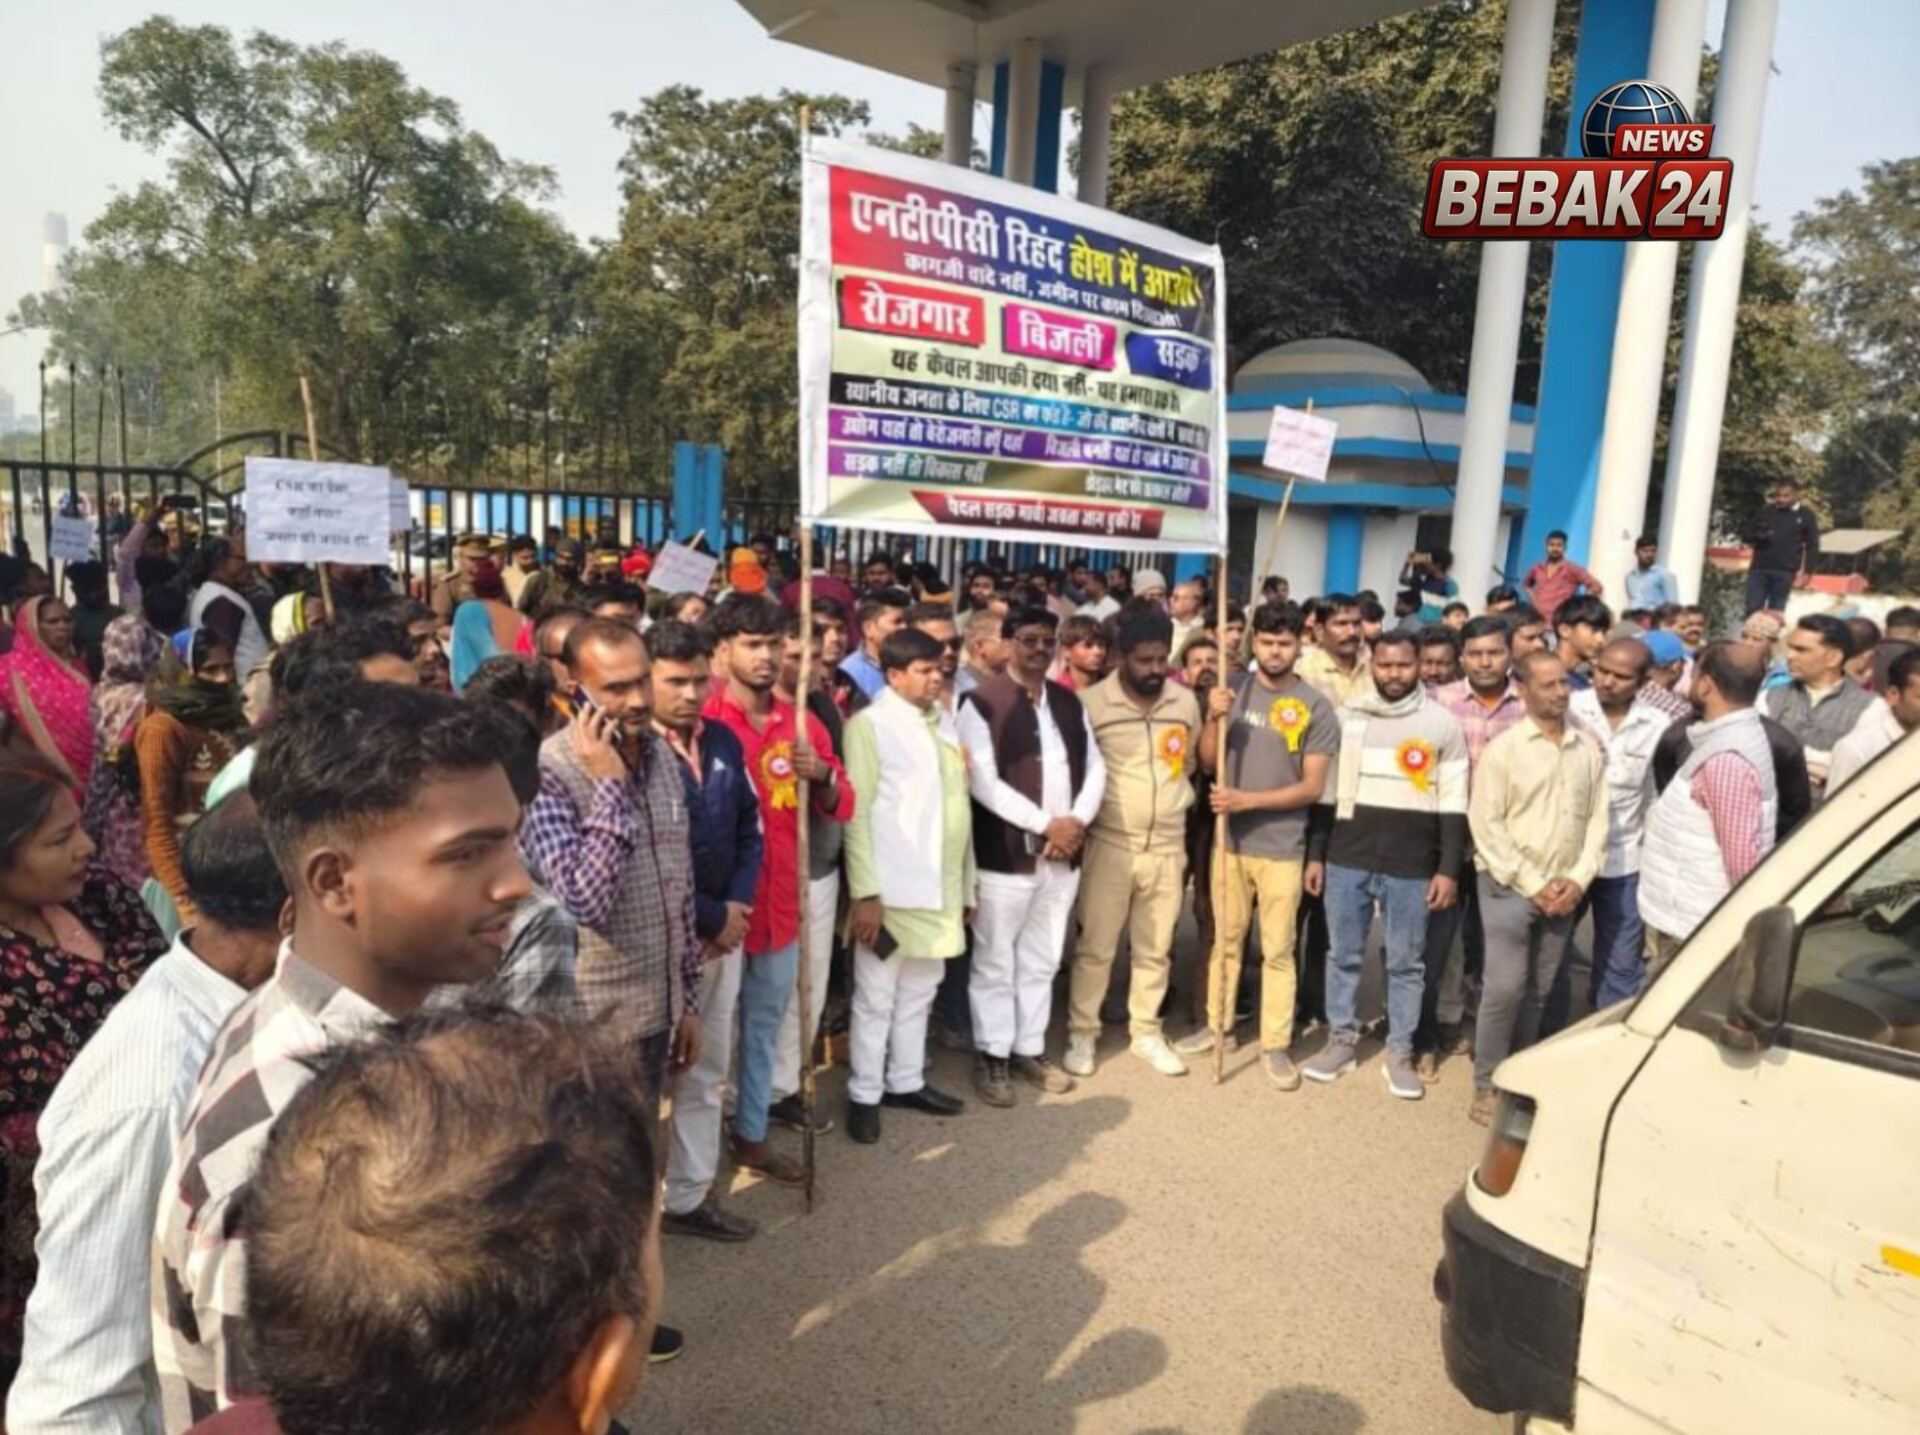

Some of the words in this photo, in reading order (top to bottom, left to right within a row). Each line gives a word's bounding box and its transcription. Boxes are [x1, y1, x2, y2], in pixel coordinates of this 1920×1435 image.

[849, 191, 1000, 259] एनटीपीसी
[1004, 216, 1065, 275] रिहंद
[1069, 234, 1116, 287] होश
[1119, 248, 1138, 292] में
[904, 252, 964, 280] कागजी
[1037, 280, 1079, 305] जमीन
[1082, 291, 1098, 310] पर
[860, 281, 971, 337] रोजगार
[1018, 309, 1103, 361] बिजली
[891, 349, 919, 372] यह
[926, 348, 972, 380] केवल
[975, 361, 1028, 388] आपकी
[1032, 370, 1058, 392] दया
[1154, 338, 1202, 379] सड़क
[845, 379, 900, 405] स्थानीय
[903, 387, 944, 411] जनता
[947, 388, 961, 412] के
[963, 389, 990, 416] लिए
[992, 397, 1020, 420] CSR
